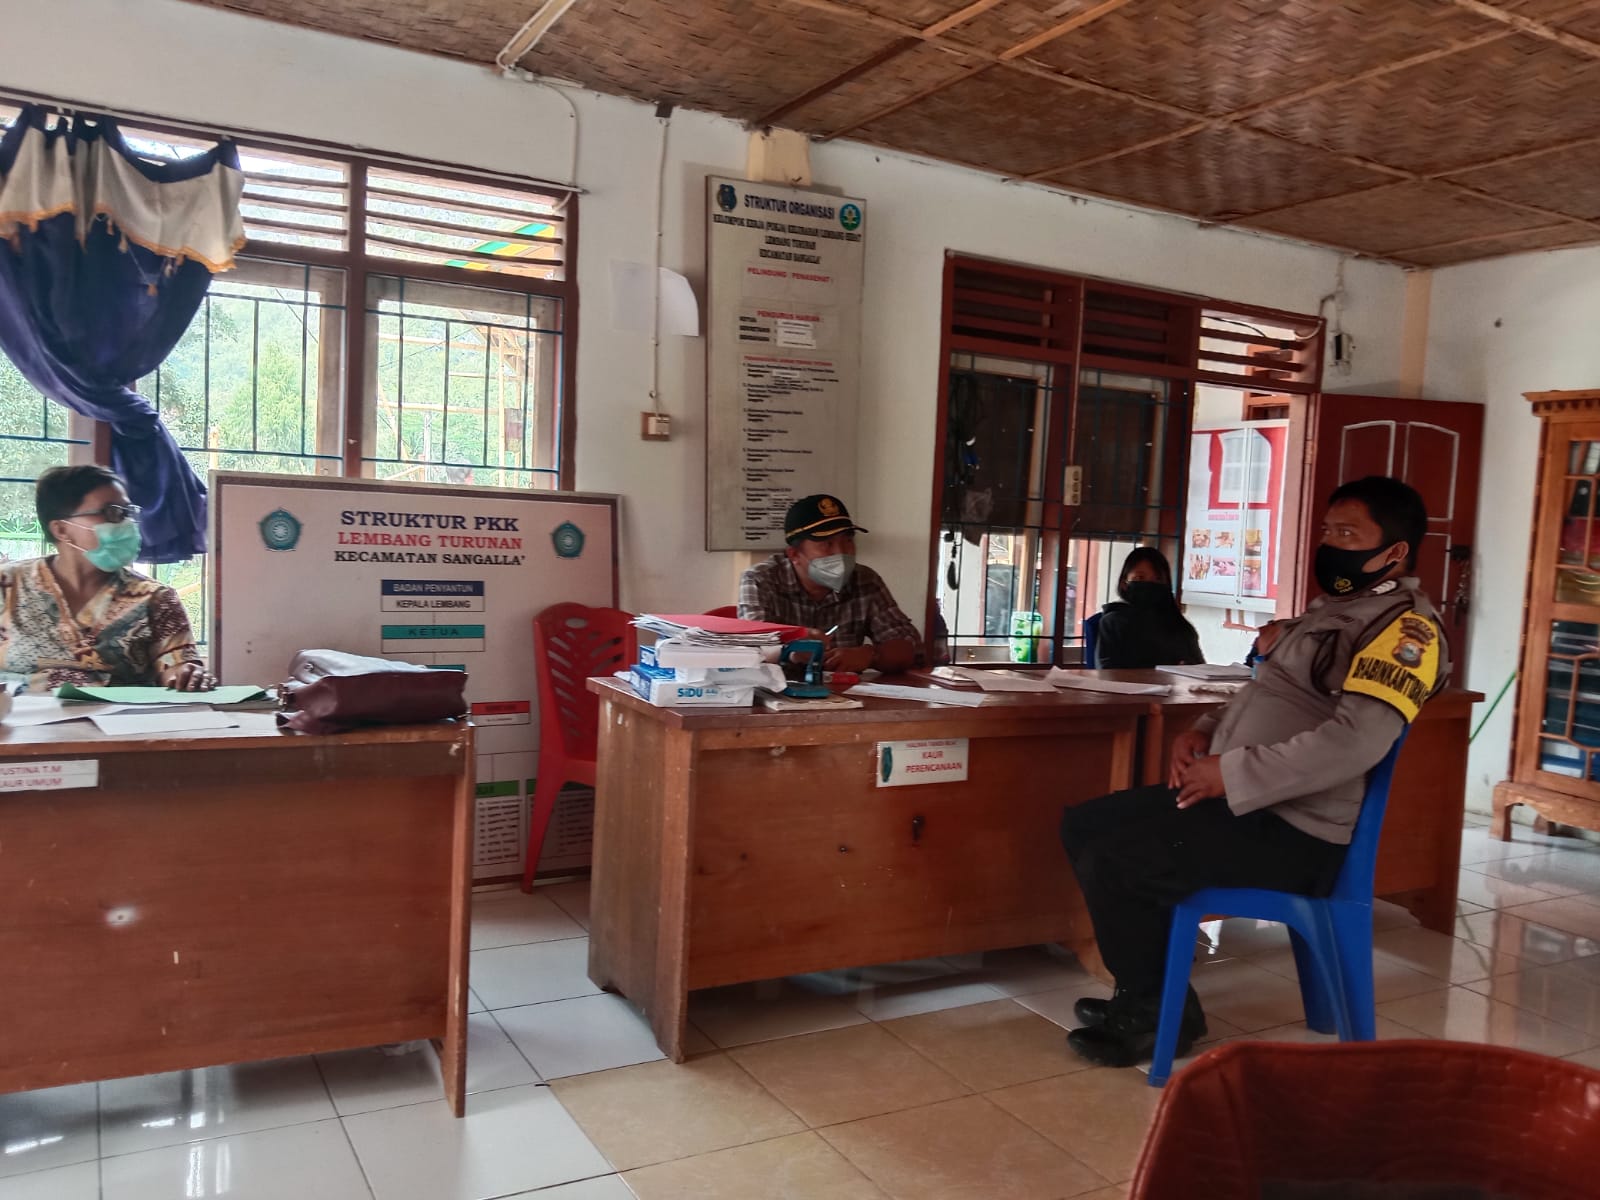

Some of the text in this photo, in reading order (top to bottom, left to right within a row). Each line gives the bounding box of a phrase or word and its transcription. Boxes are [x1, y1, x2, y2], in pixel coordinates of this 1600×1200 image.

[743, 194, 835, 220] STRUKTUR ORGANISASI
[341, 510, 519, 532] STRUKTUR PKK
[338, 531, 522, 550] LEMBANG TURUNAN
[334, 550, 438, 564] KECAMATAN
[393, 583, 474, 593] BADAN PENYANTUN
[396, 600, 471, 609] KEPALA LEMBANG
[922, 750, 944, 759] KAUR
[0, 766, 40, 776] USTINA
[905, 762, 962, 773] PERENCANAAN
[0, 779, 22, 789] AUR
